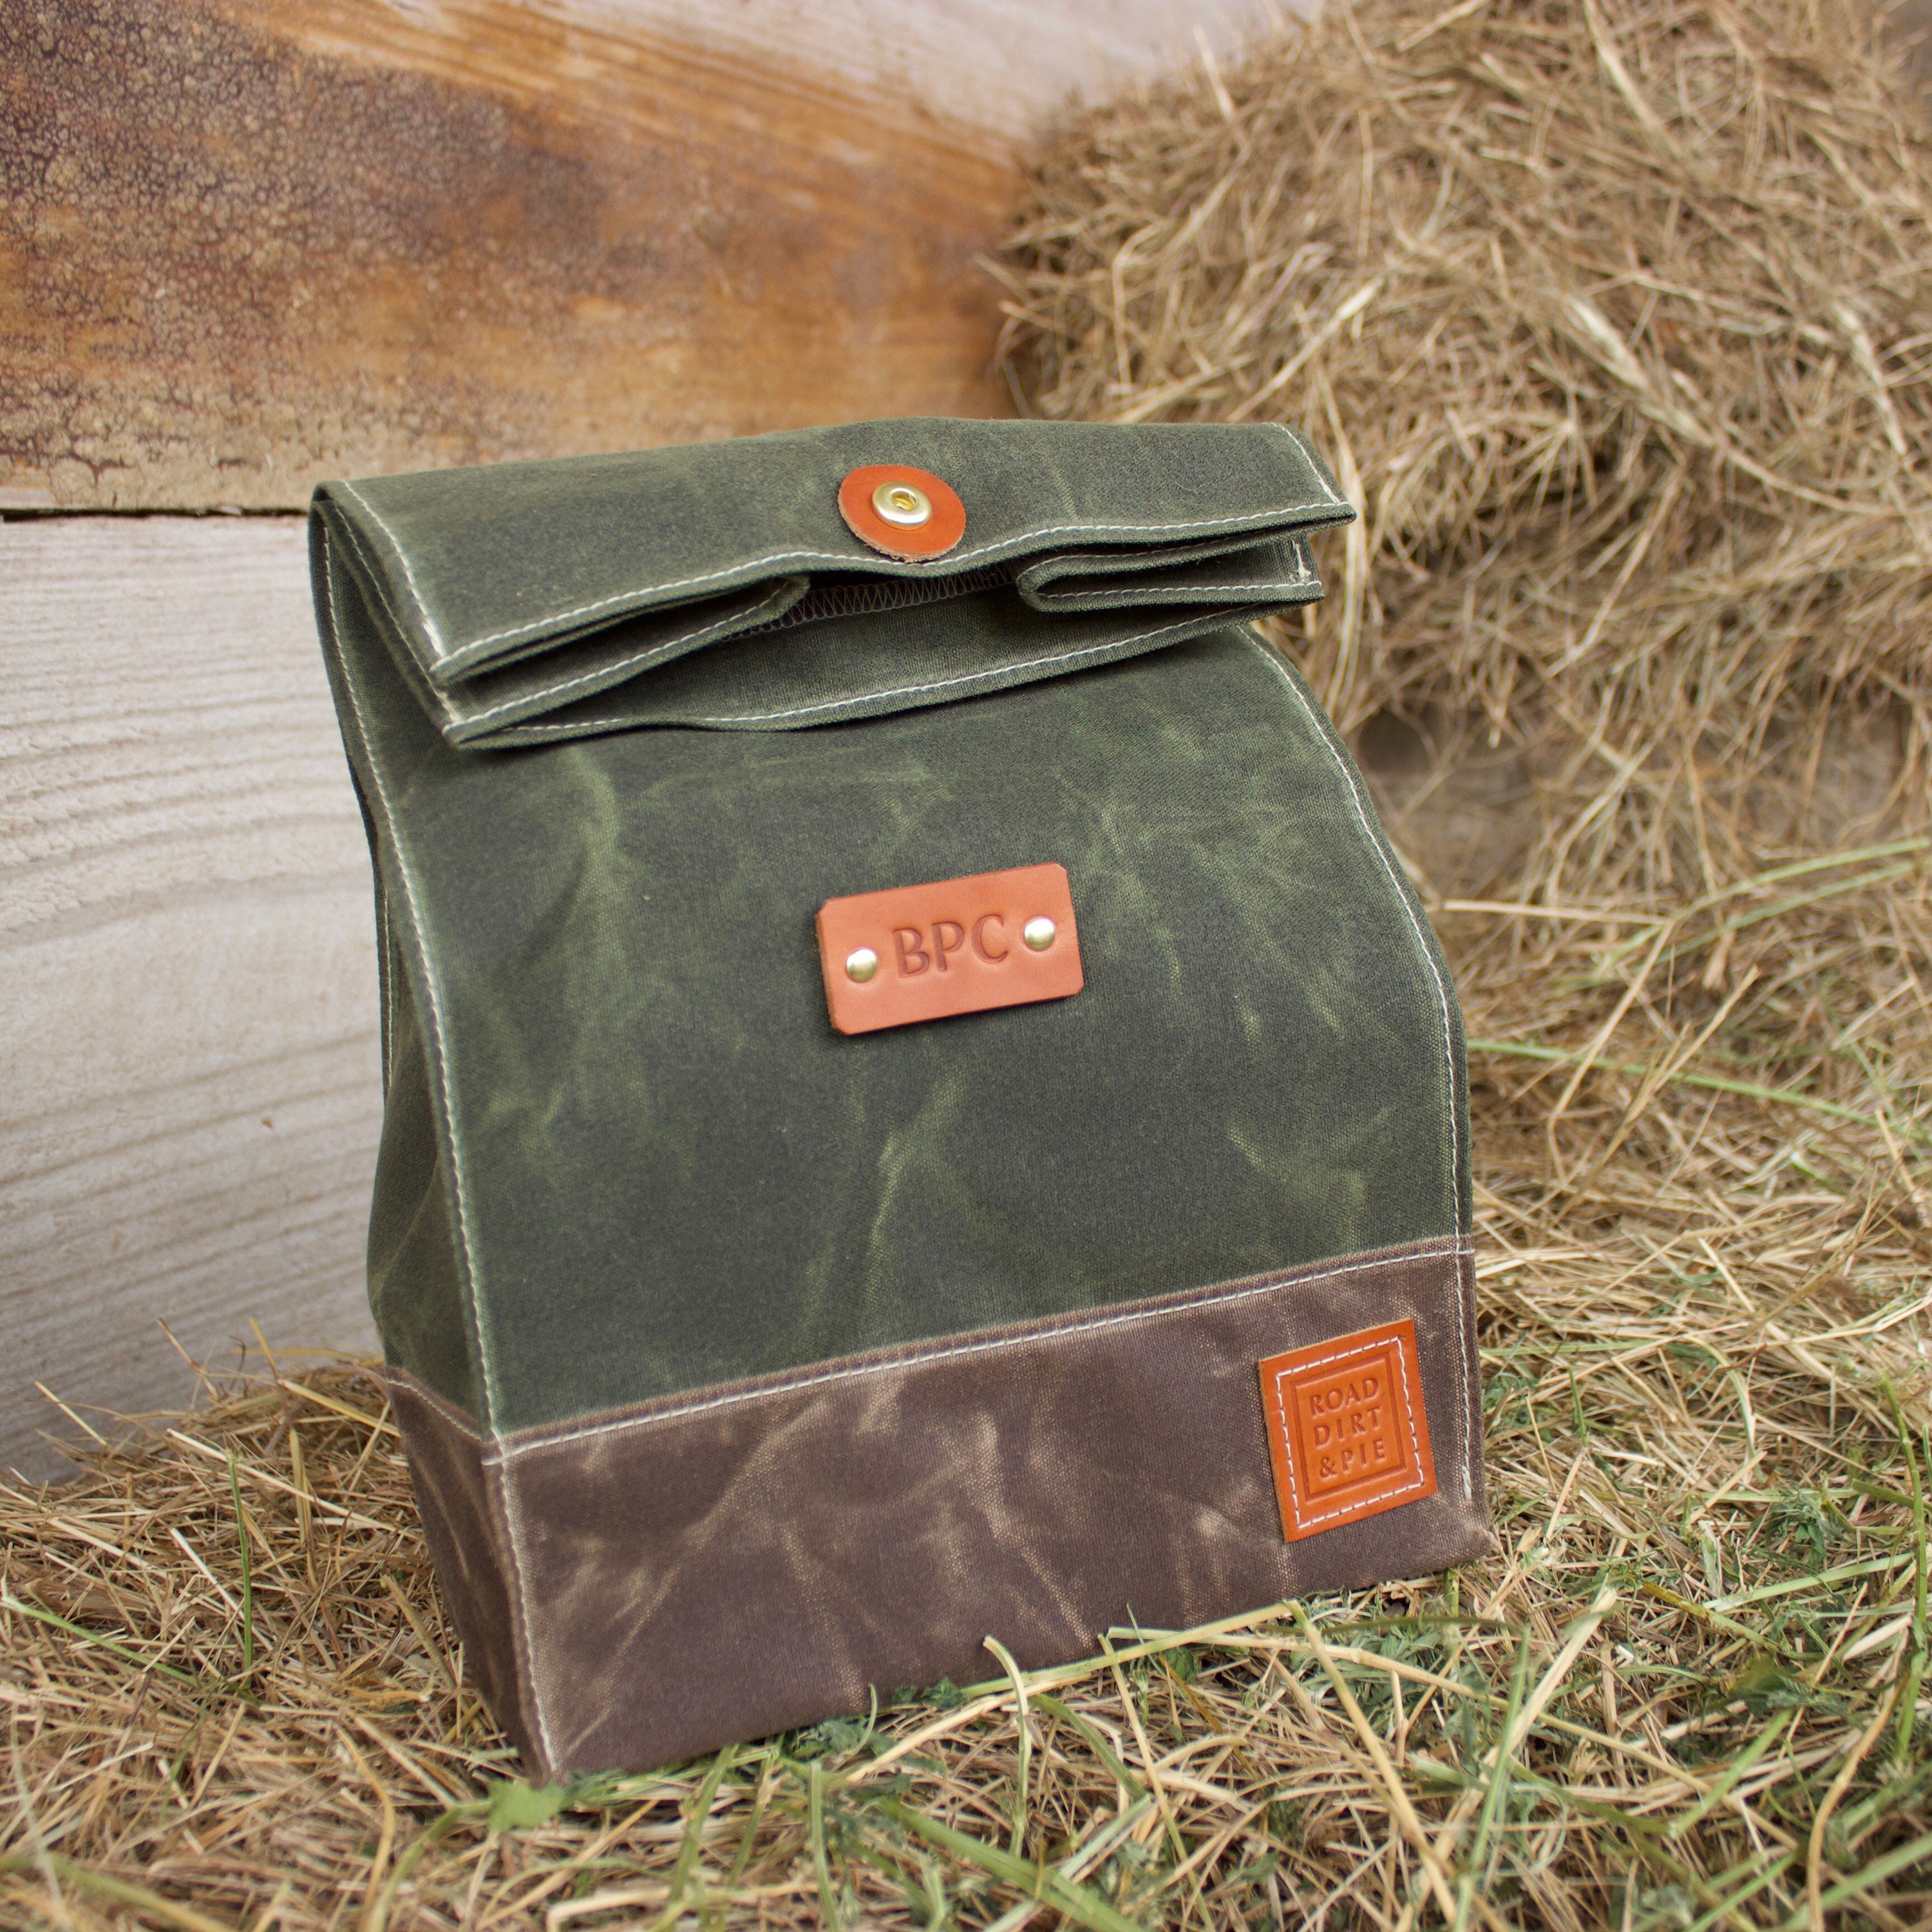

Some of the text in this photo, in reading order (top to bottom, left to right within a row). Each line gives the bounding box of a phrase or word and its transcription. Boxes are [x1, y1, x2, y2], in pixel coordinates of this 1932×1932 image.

[893, 913, 1009, 978] BPC
[1309, 1377, 1379, 1417] ROAD
[1314, 1406, 1380, 1448] DIRT
[1320, 1438, 1385, 1479] &PIE
